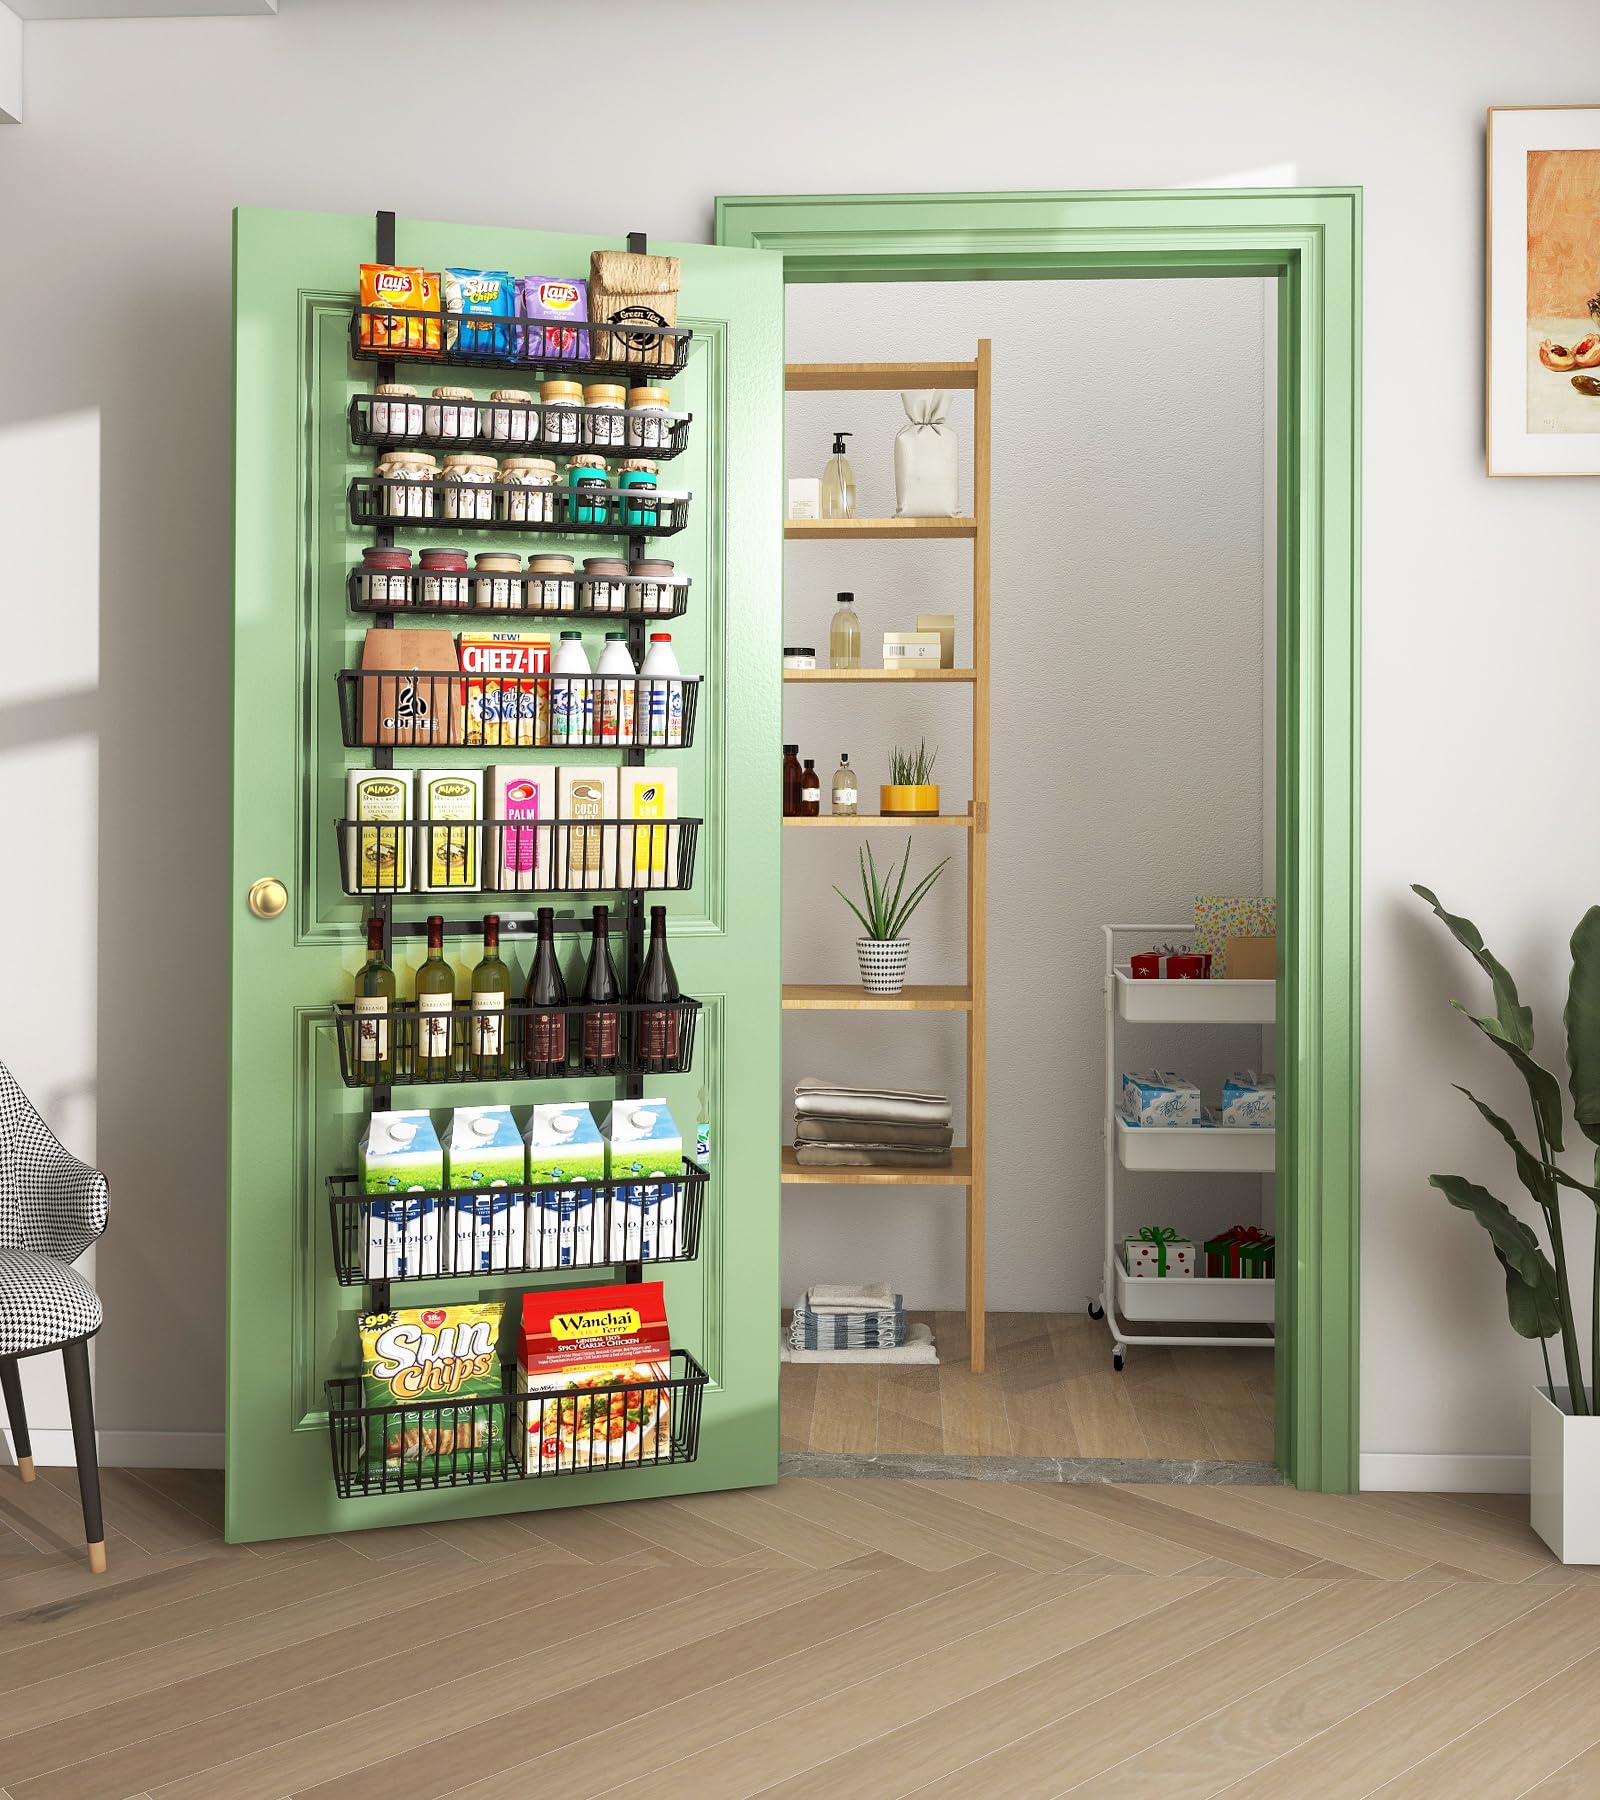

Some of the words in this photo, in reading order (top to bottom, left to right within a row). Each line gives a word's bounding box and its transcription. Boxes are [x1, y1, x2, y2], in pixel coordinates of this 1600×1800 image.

[463, 279, 500, 298] Sun
[469, 290, 499, 305] Chips
[620, 311, 644, 319] Green
[646, 311, 661, 323] Tea
[492, 633, 520, 641] NEW!
[463, 646, 548, 673] CHEEZ-IT
[367, 785, 397, 795] MINOS
[438, 785, 468, 795] MINOS
[509, 808, 535, 820] PALM
[575, 803, 598, 815] COCO
[575, 825, 598, 837] OL
[637, 826, 656, 839] OL
[616, 1218, 673, 1229] МООКО
[558, 1311, 632, 1331] Wanchai
[603, 1325, 628, 1335] Ferry
[557, 1343, 578, 1353] SPICY
[578, 1340, 606, 1350] GARLIC
[606, 1337, 640, 1347] CHICKEN
[575, 1336, 603, 1345] GENERAL
[373, 1321, 496, 1379] Sun
[389, 1352, 493, 1398] Chips
[546, 1443, 557, 1453] 14
